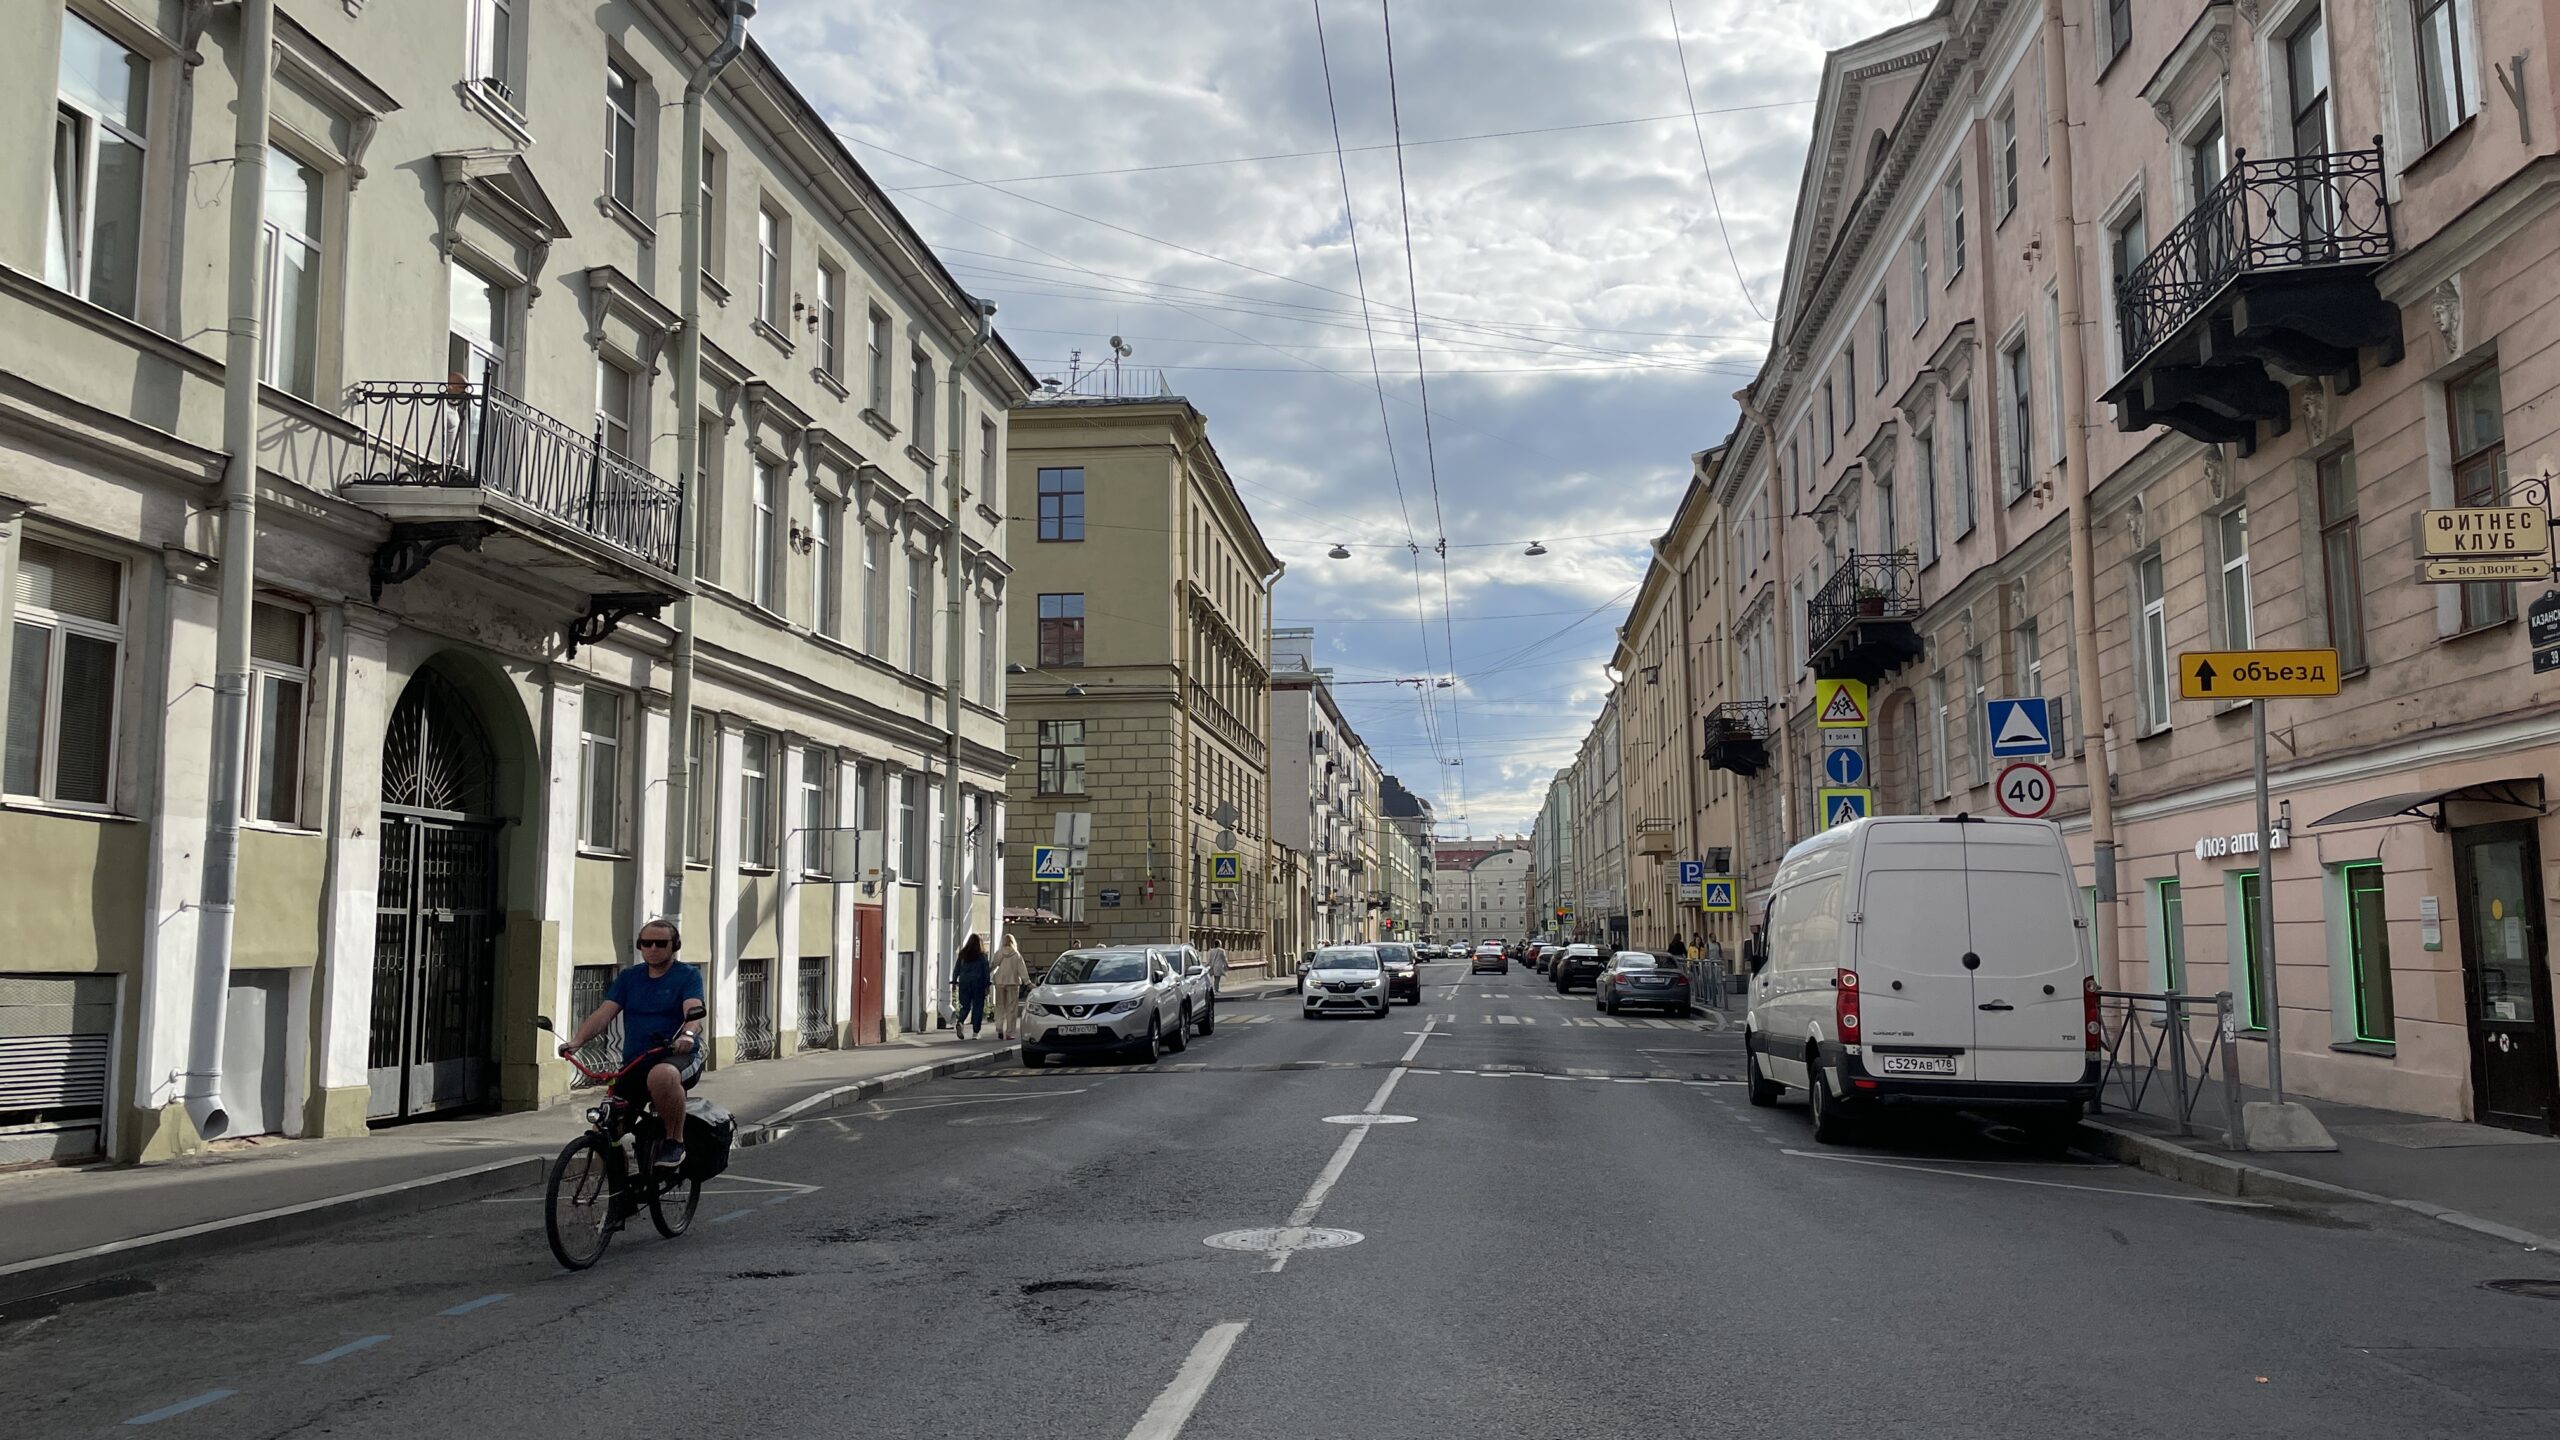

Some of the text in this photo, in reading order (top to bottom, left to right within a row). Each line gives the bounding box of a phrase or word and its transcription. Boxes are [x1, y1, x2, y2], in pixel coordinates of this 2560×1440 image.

[2438, 512, 2531, 531] ФИТНЕС
[2455, 533, 2515, 550] КЛУБ
[2458, 565, 2519, 576] ВО ДВОРЕ
[2232, 661, 2325, 682] объезд
[2008, 778, 2044, 802] 40
[2230, 828, 2281, 854] апта
